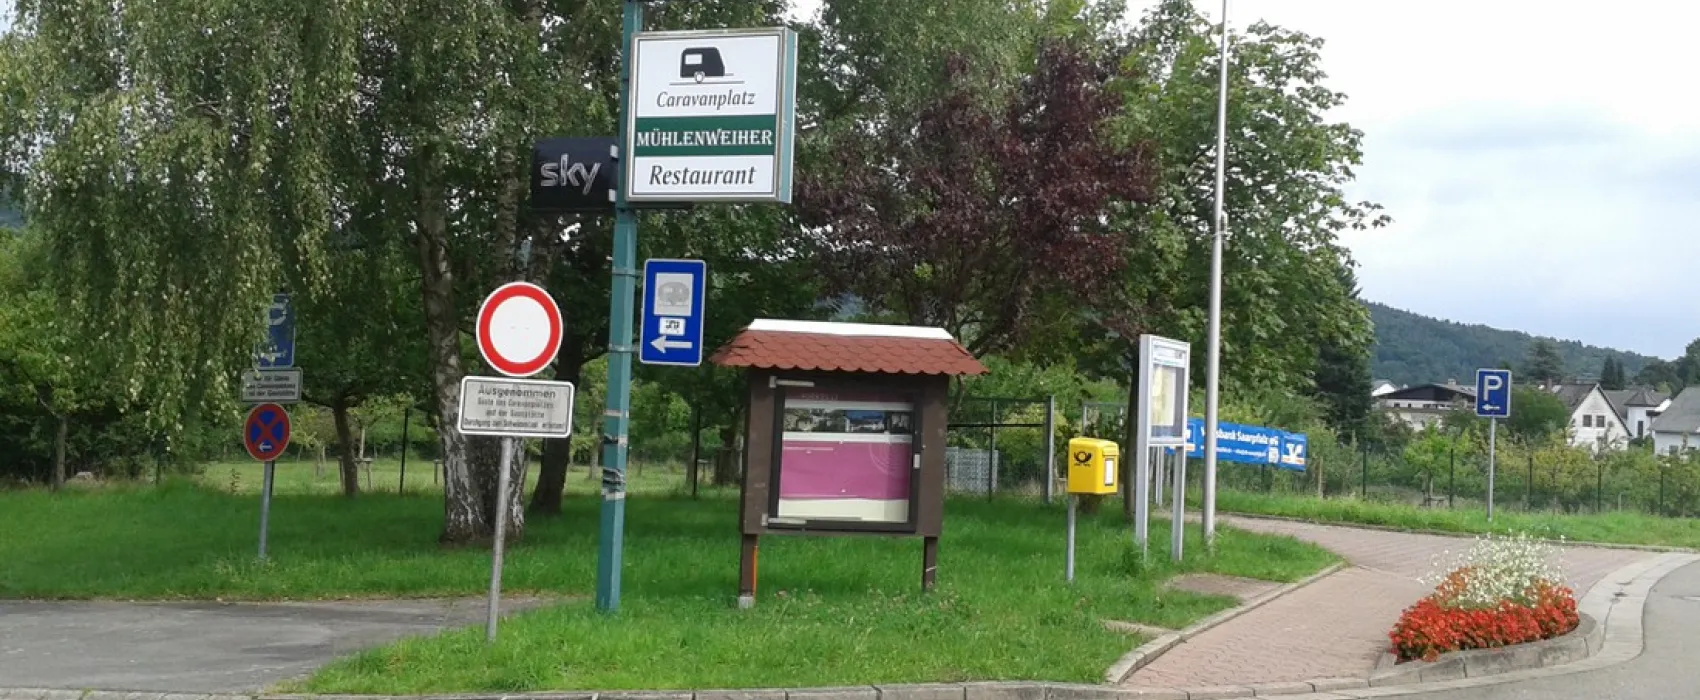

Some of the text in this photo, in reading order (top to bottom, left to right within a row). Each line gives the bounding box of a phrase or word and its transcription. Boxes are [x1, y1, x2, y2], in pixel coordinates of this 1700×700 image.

[656, 89, 756, 110] Caravanplatz
[636, 128, 773, 147] MÜHLENWEIHER
[540, 153, 602, 195] sky
[649, 164, 757, 185] Restaurant
[478, 384, 556, 398] Ausgenommen
[1483, 375, 1503, 401] P
